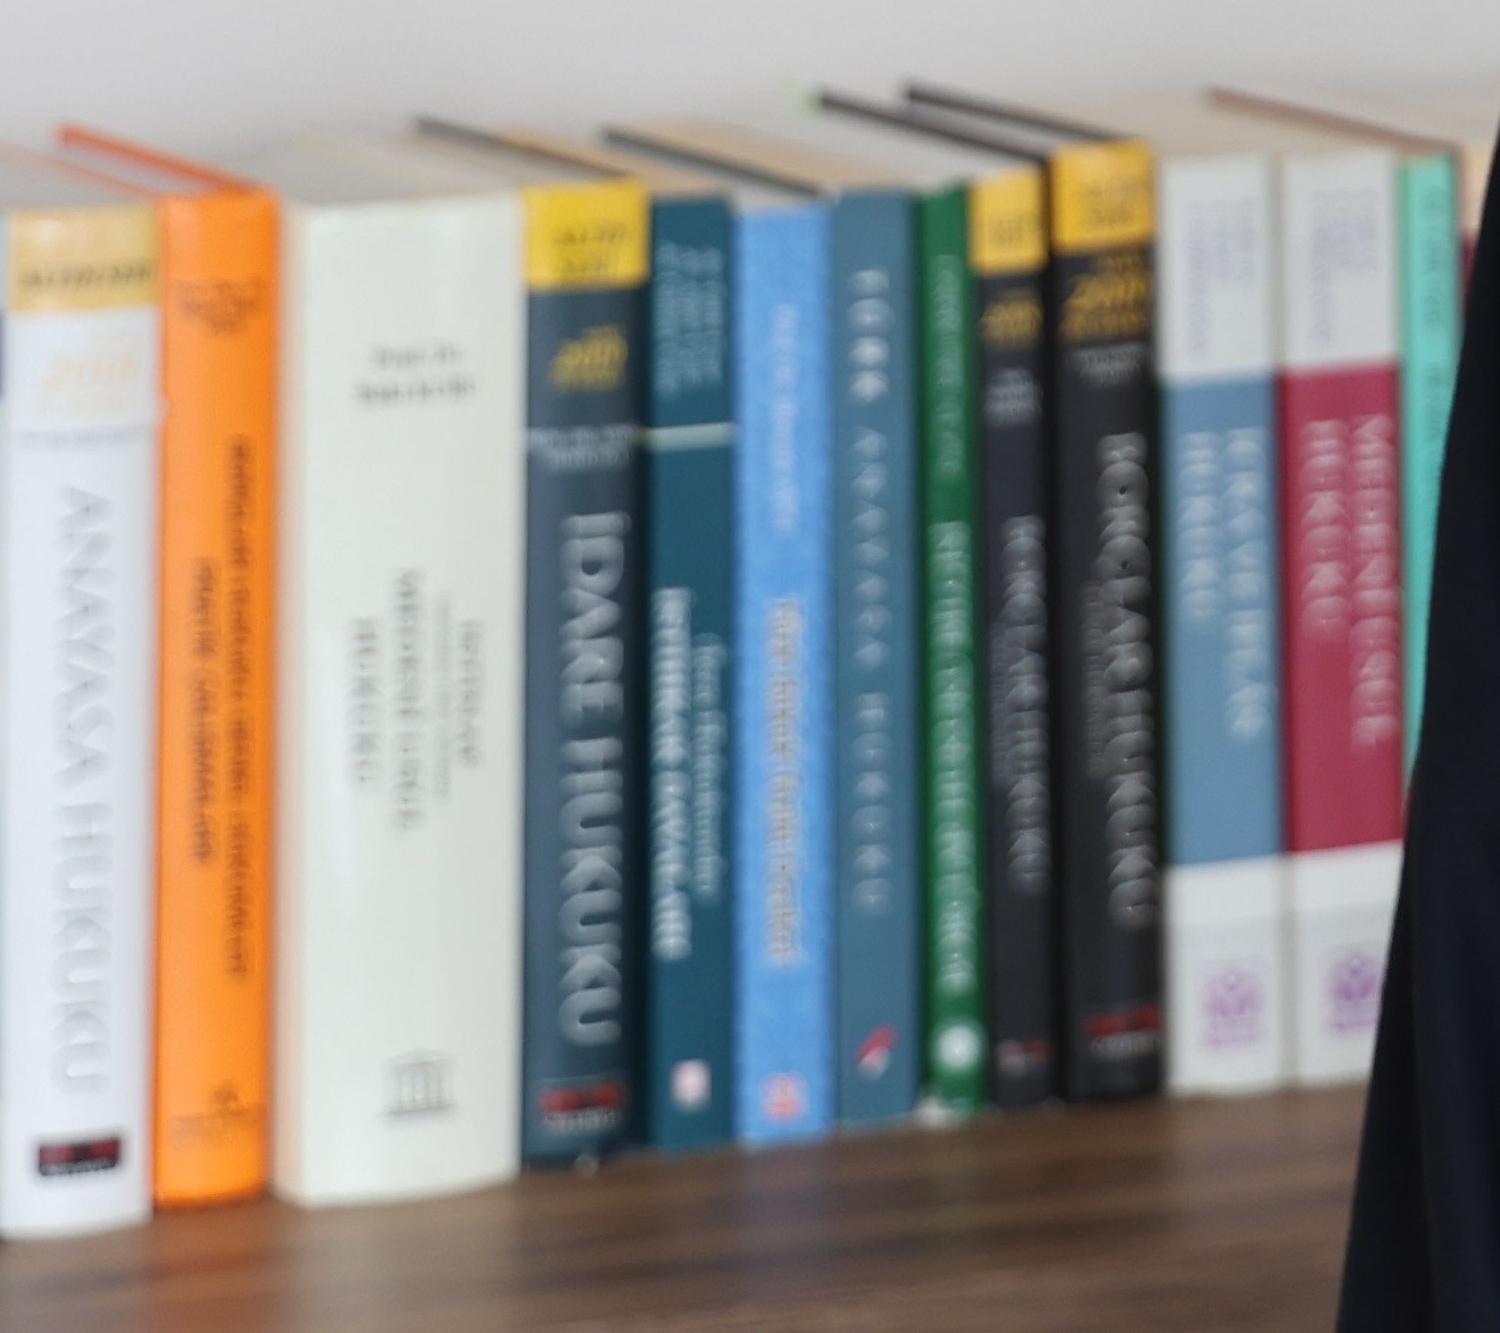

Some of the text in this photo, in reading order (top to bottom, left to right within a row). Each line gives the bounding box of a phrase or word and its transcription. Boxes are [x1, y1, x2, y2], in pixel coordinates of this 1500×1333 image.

[561, 512, 629, 719] İDARE
[1100, 434, 1150, 690] BORÇLAR
[56, 485, 112, 1093] ANAYASA HUKUKU
[559, 737, 622, 1046] HUKUKU
[1104, 692, 1156, 930] HUKUKU
